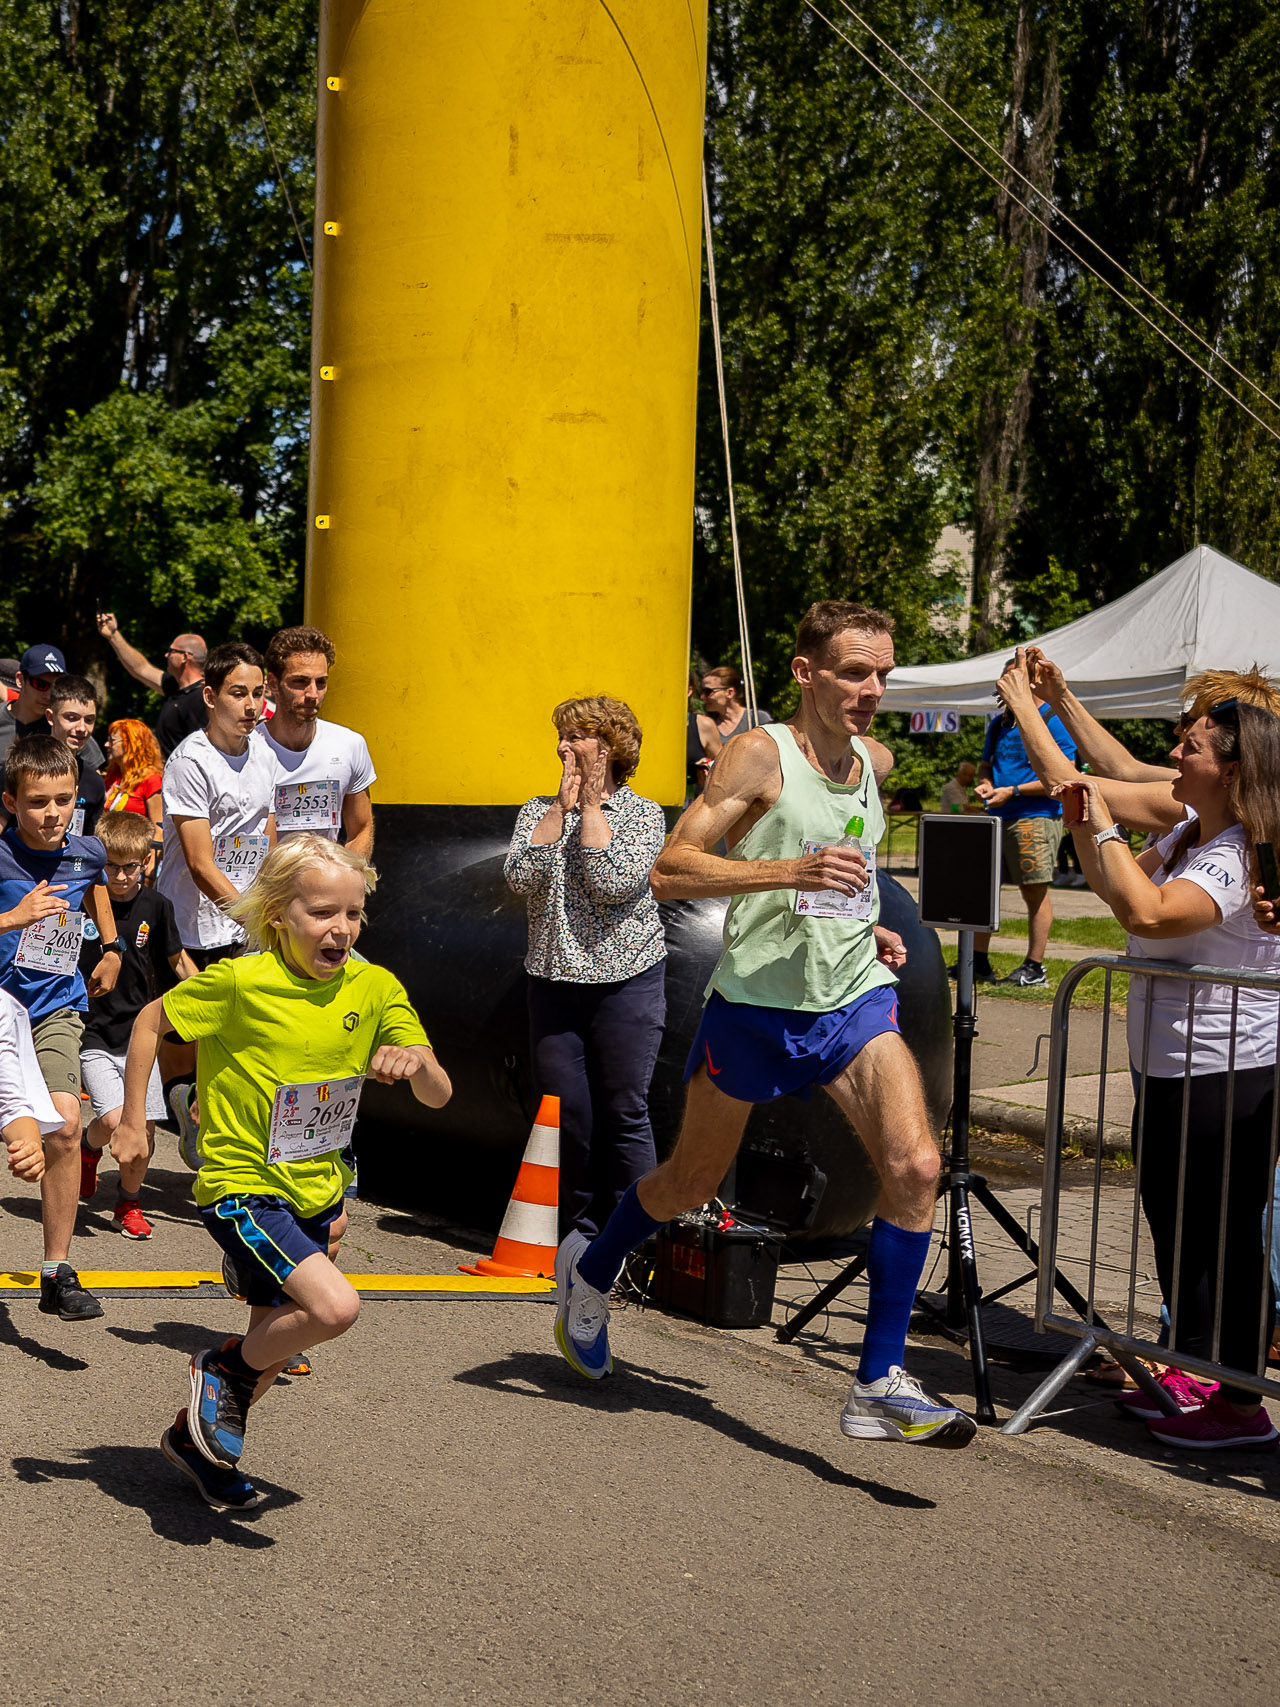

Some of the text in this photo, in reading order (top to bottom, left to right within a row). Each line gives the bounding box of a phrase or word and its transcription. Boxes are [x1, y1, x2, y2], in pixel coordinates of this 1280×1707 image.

[293, 795, 329, 810] 2553
[226, 850, 258, 865] 2612
[1191, 861, 1236, 888] HUN
[45, 929, 81, 950] 2685
[304, 1098, 357, 1128] 2692
[956, 1206, 974, 1260] VONYX
